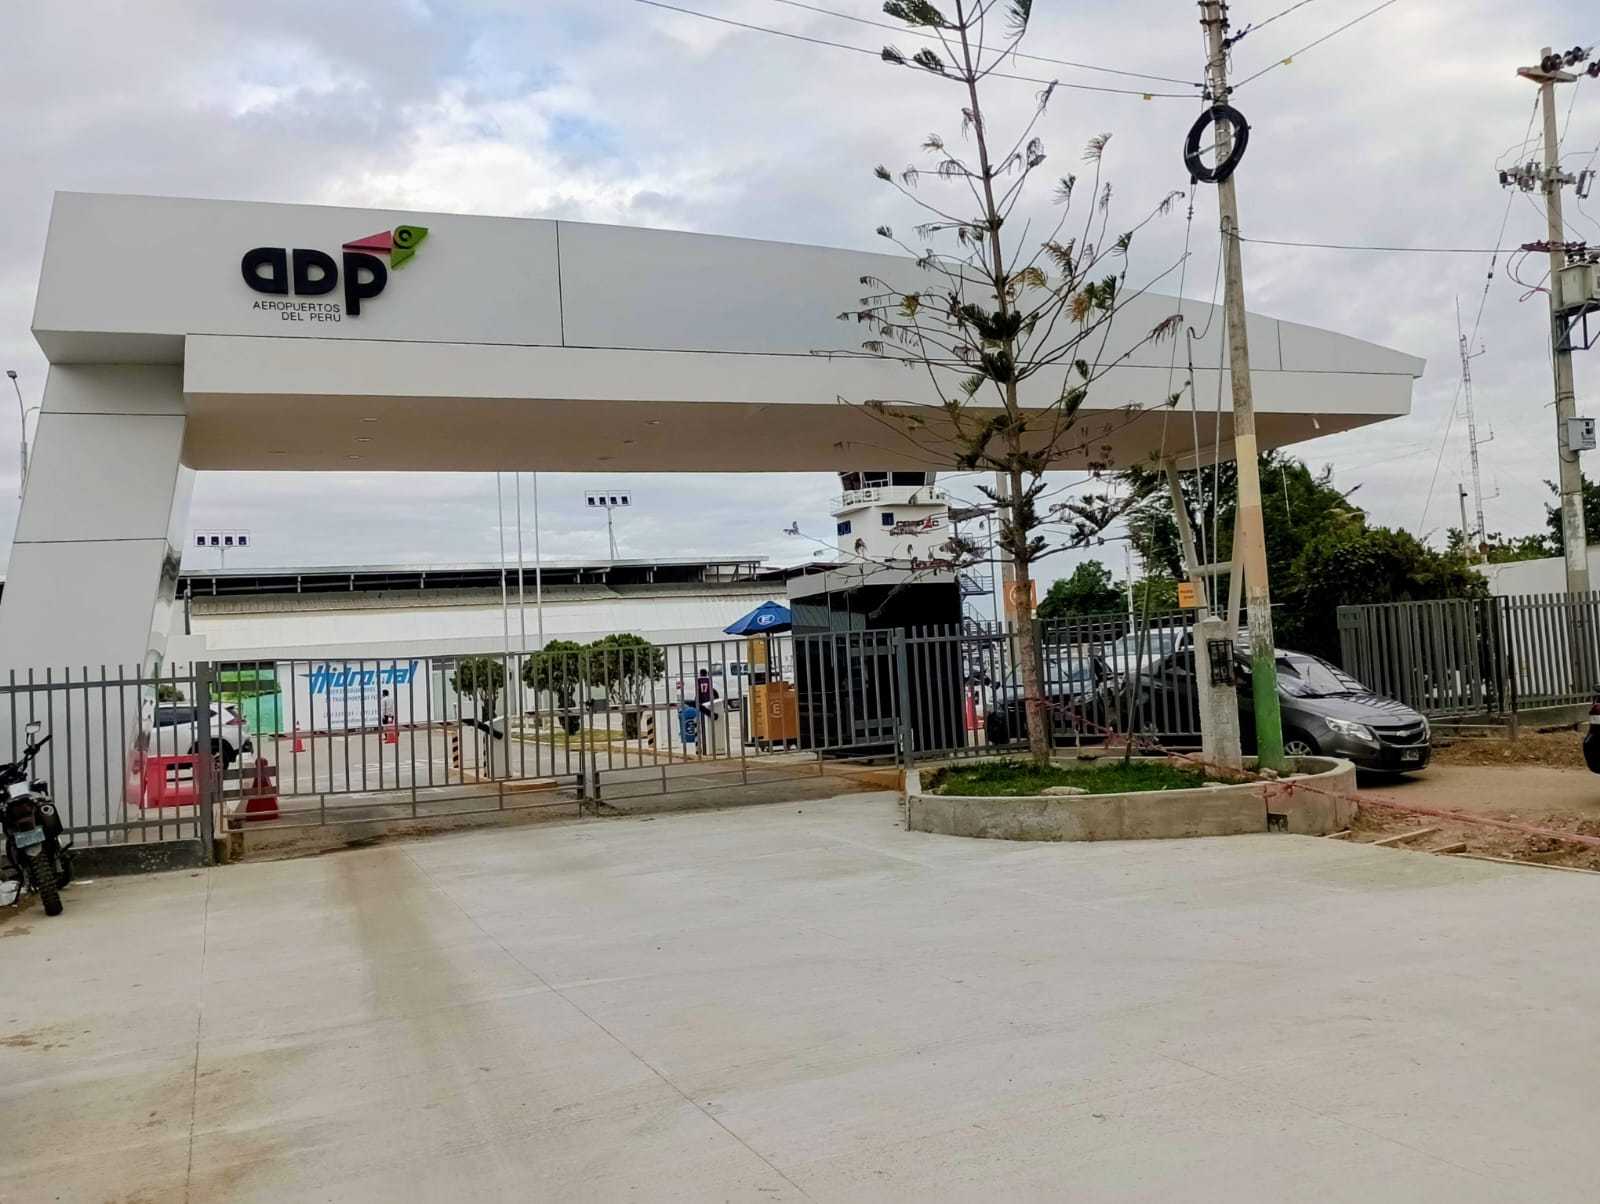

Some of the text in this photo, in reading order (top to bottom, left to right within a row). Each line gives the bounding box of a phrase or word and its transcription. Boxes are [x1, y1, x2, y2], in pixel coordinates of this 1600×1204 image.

[252, 301, 340, 312] AEROPUERTOS
[281, 312, 304, 321] DEL
[298, 660, 419, 695] Hidrotal
